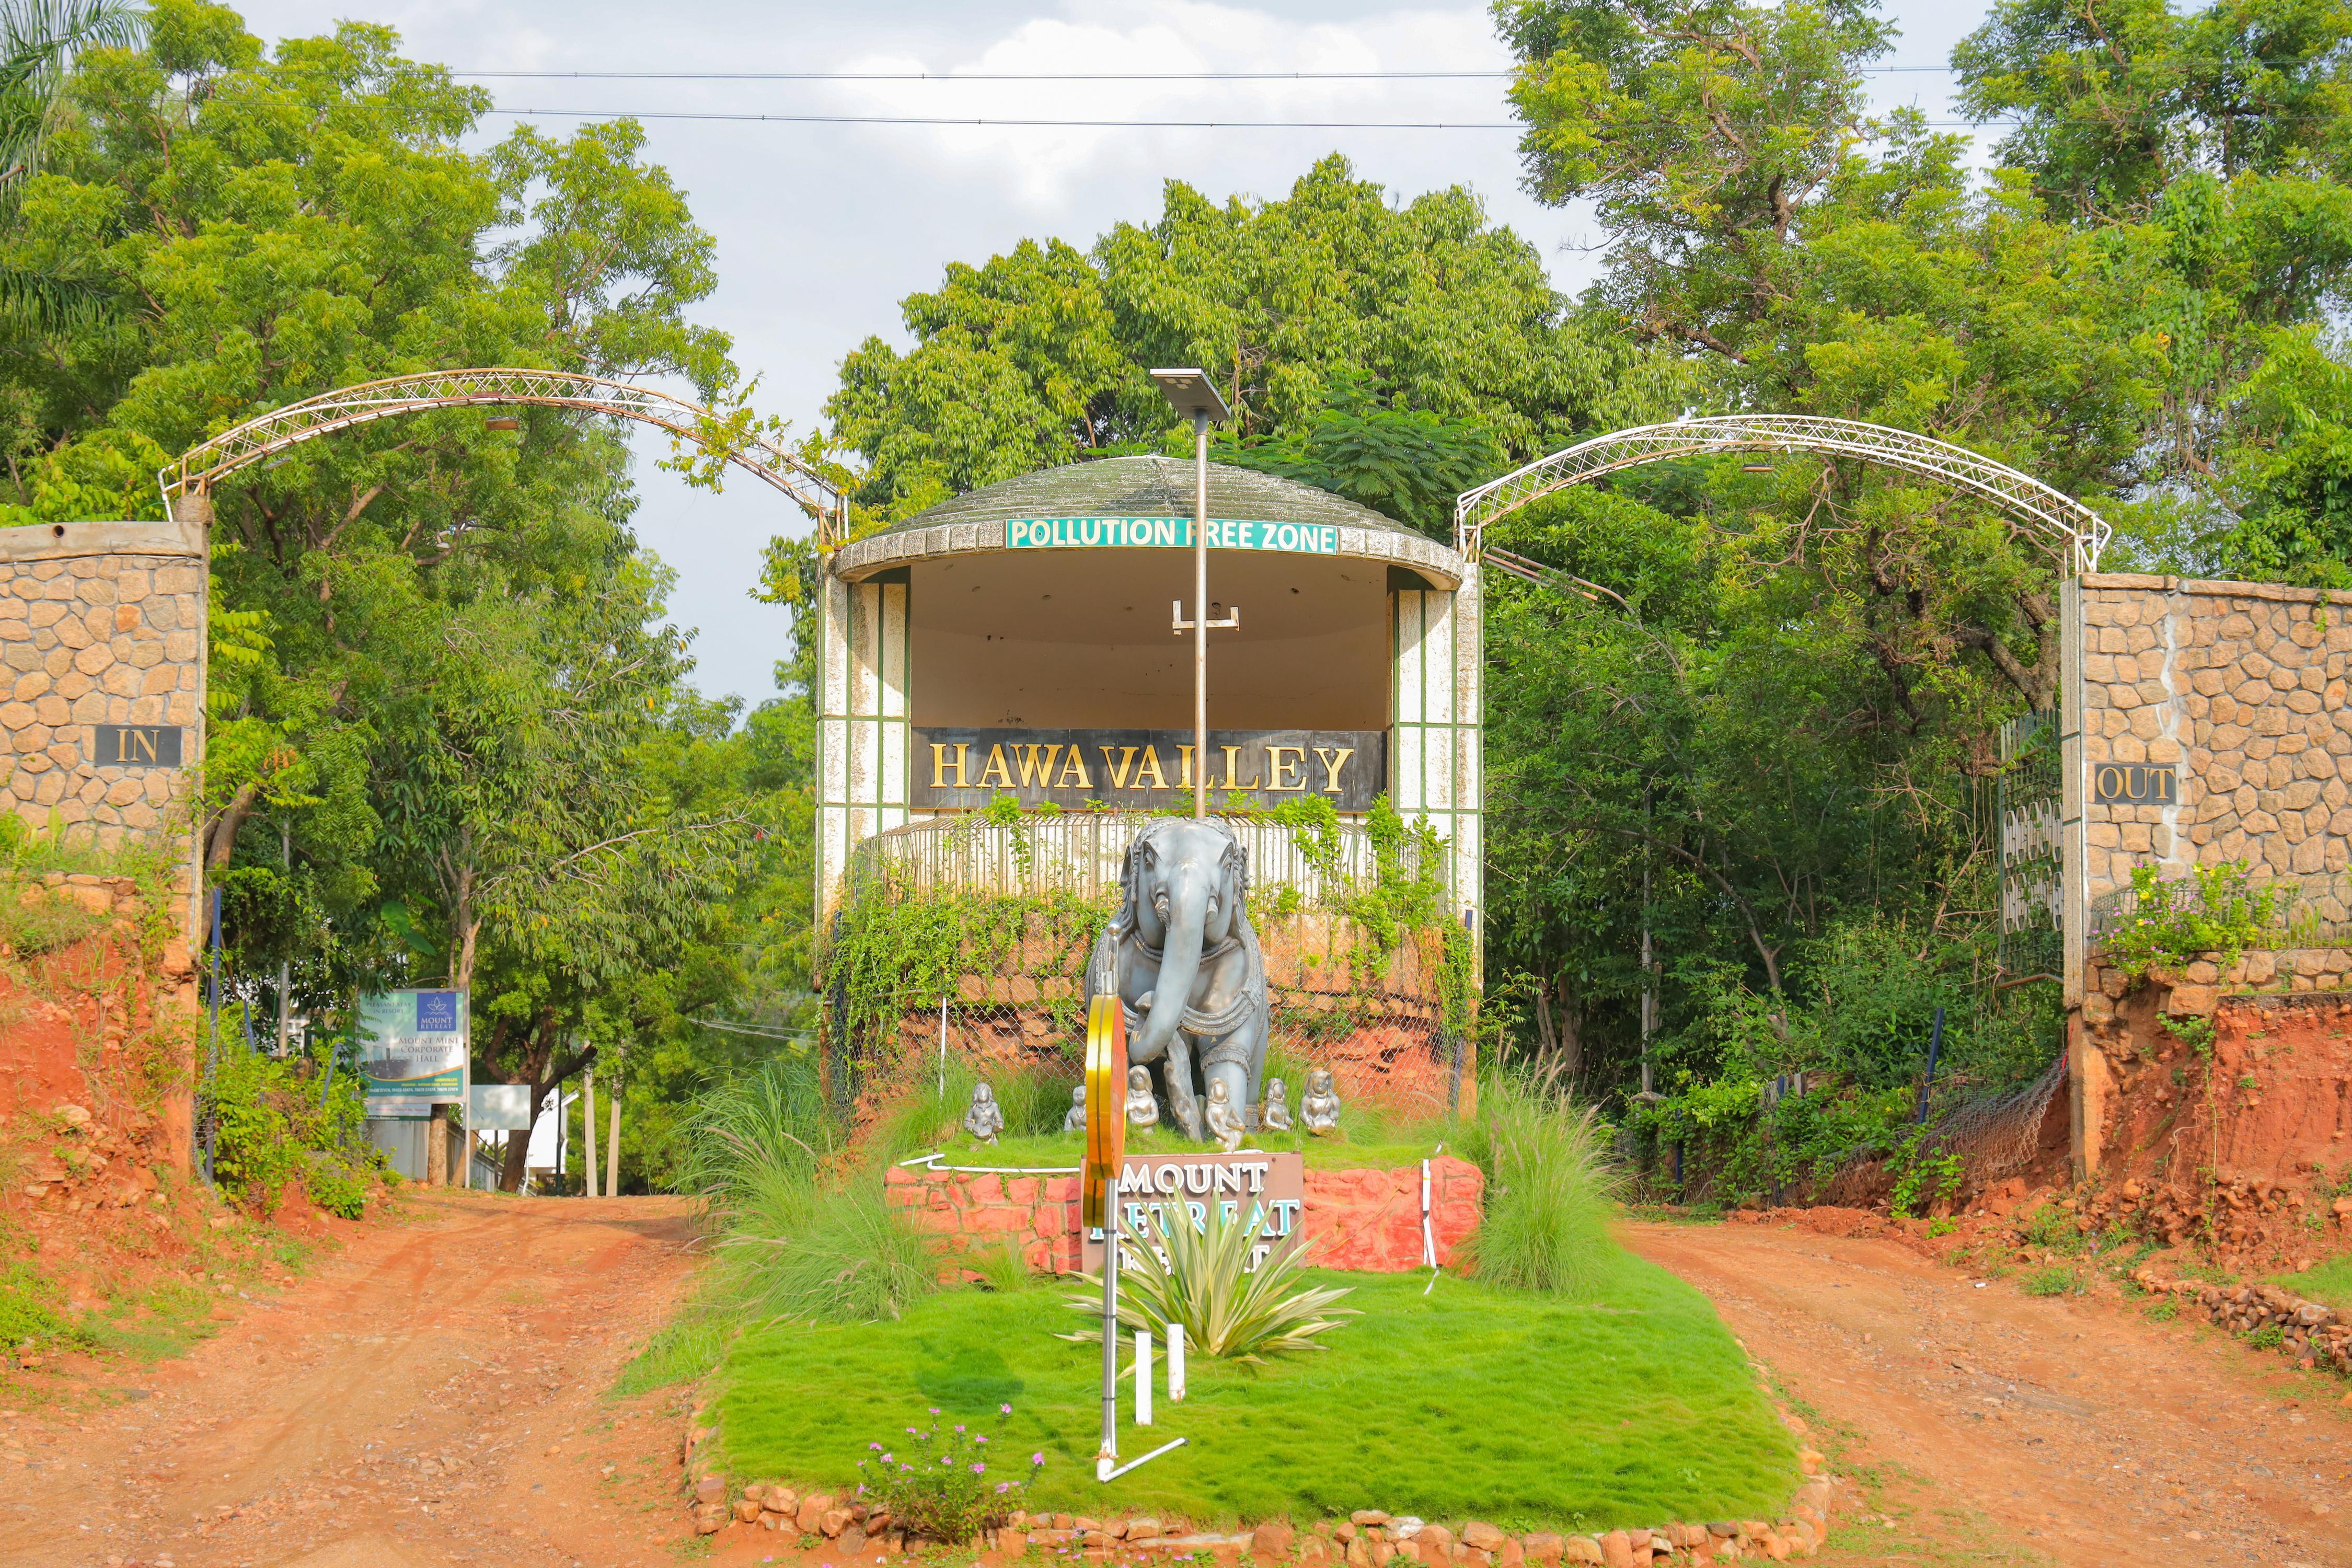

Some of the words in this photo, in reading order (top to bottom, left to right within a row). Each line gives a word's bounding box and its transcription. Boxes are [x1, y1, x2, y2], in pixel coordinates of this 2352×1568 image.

[1011, 518, 1176, 547] POLLUTION
[1186, 518, 1253, 548] FREE
[1262, 523, 1334, 553] ZONE
[116, 729, 160, 763] IN
[929, 743, 1094, 789] HAWA
[2097, 767, 2175, 800] OUT
[1119, 1162, 1269, 1194] MOUNT
[1090, 1199, 1300, 1240] ETREAT
